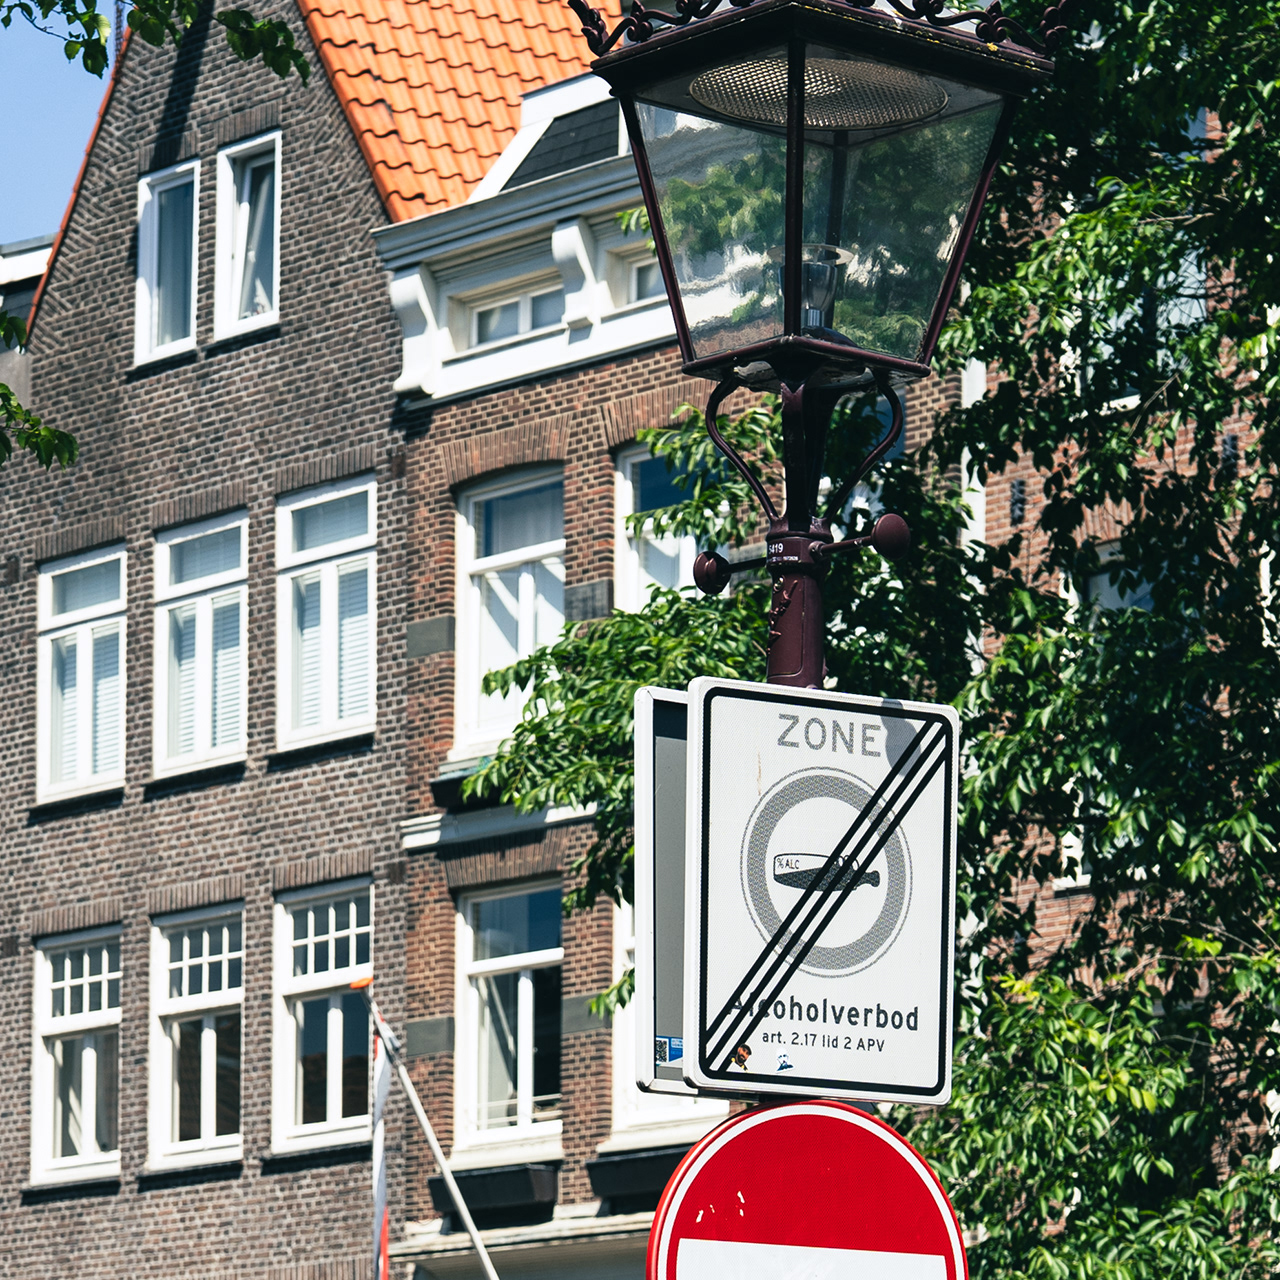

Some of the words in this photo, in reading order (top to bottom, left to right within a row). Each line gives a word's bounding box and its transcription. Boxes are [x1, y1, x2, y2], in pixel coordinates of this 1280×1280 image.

[777, 713, 882, 758] ZONE
[762, 1031, 786, 1045] art.
[791, 1032, 817, 1047] 2.17
[822, 1034, 838, 1049] lid
[844, 1036, 852, 1050] 2
[856, 1038, 885, 1052] APV
